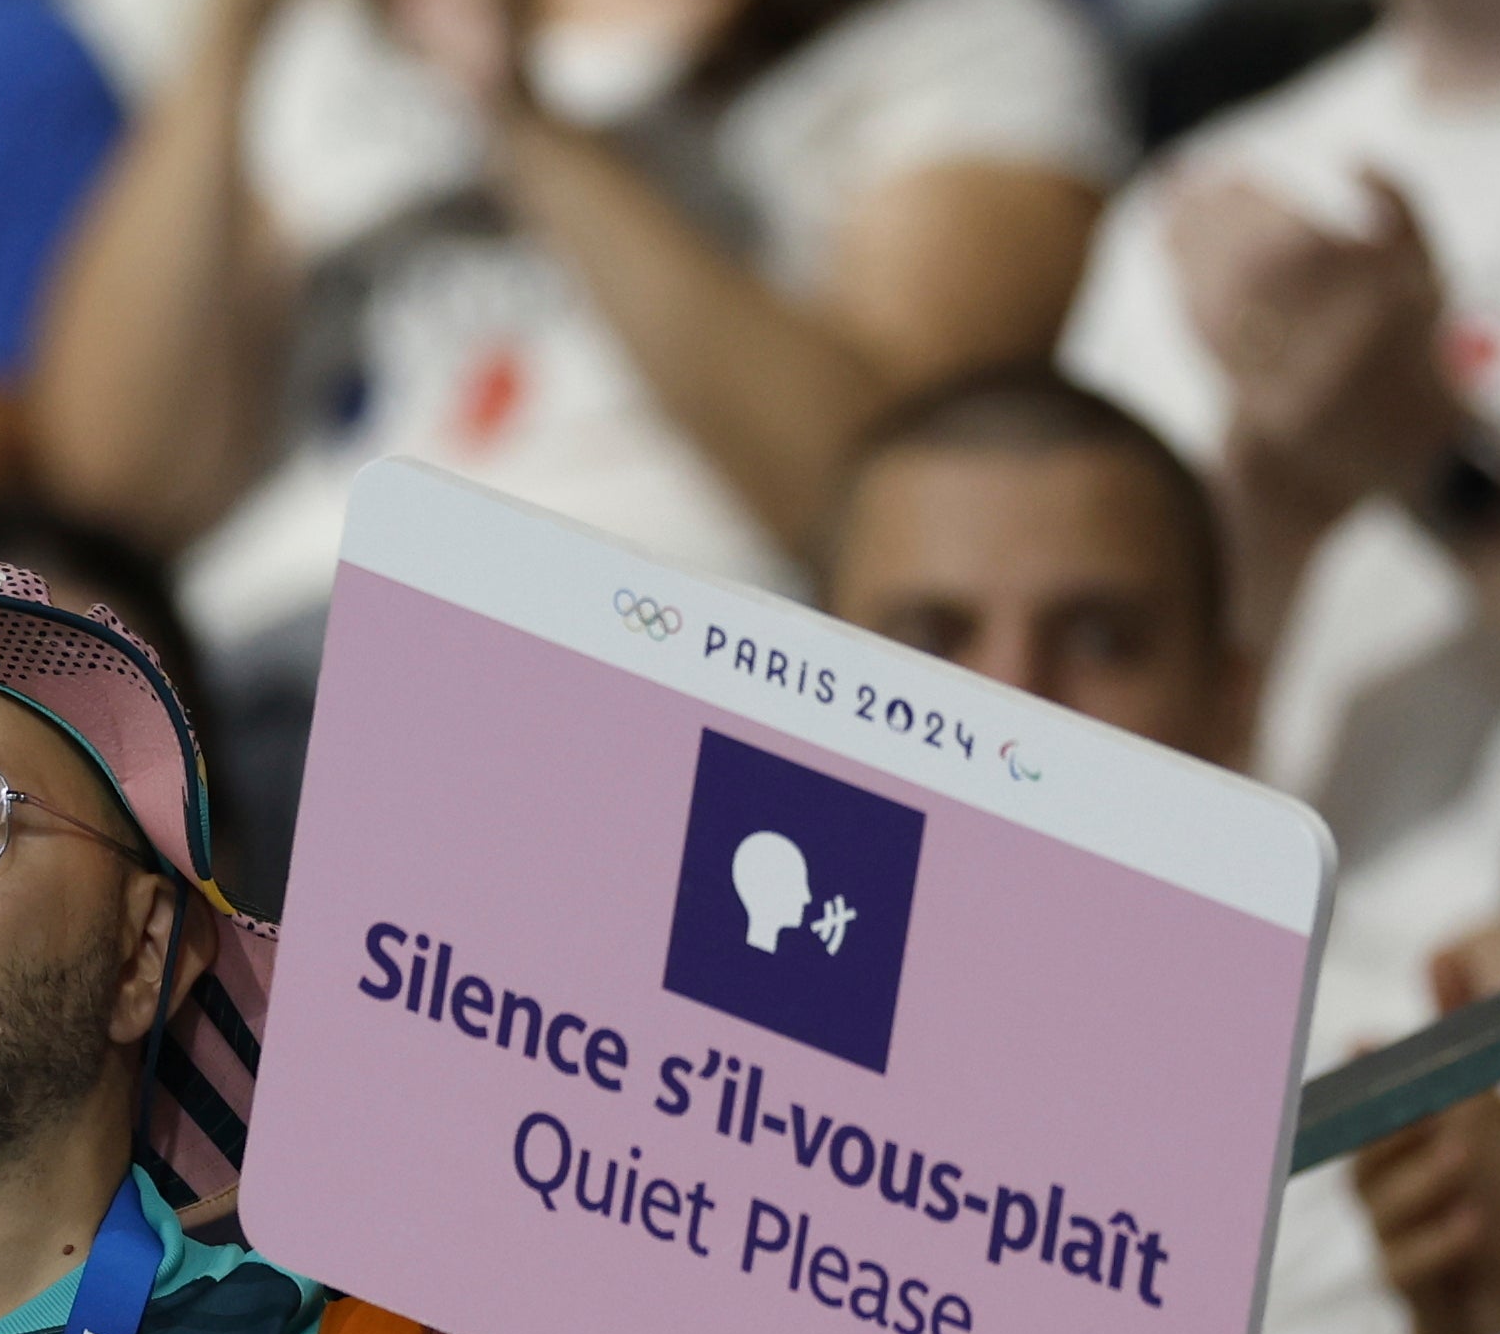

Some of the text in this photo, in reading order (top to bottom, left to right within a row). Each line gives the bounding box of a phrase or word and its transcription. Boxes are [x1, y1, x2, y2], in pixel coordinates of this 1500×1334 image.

[855, 684, 974, 759] 2024
[358, 921, 629, 1093] Silence
[513, 1111, 716, 1258] Quiet
